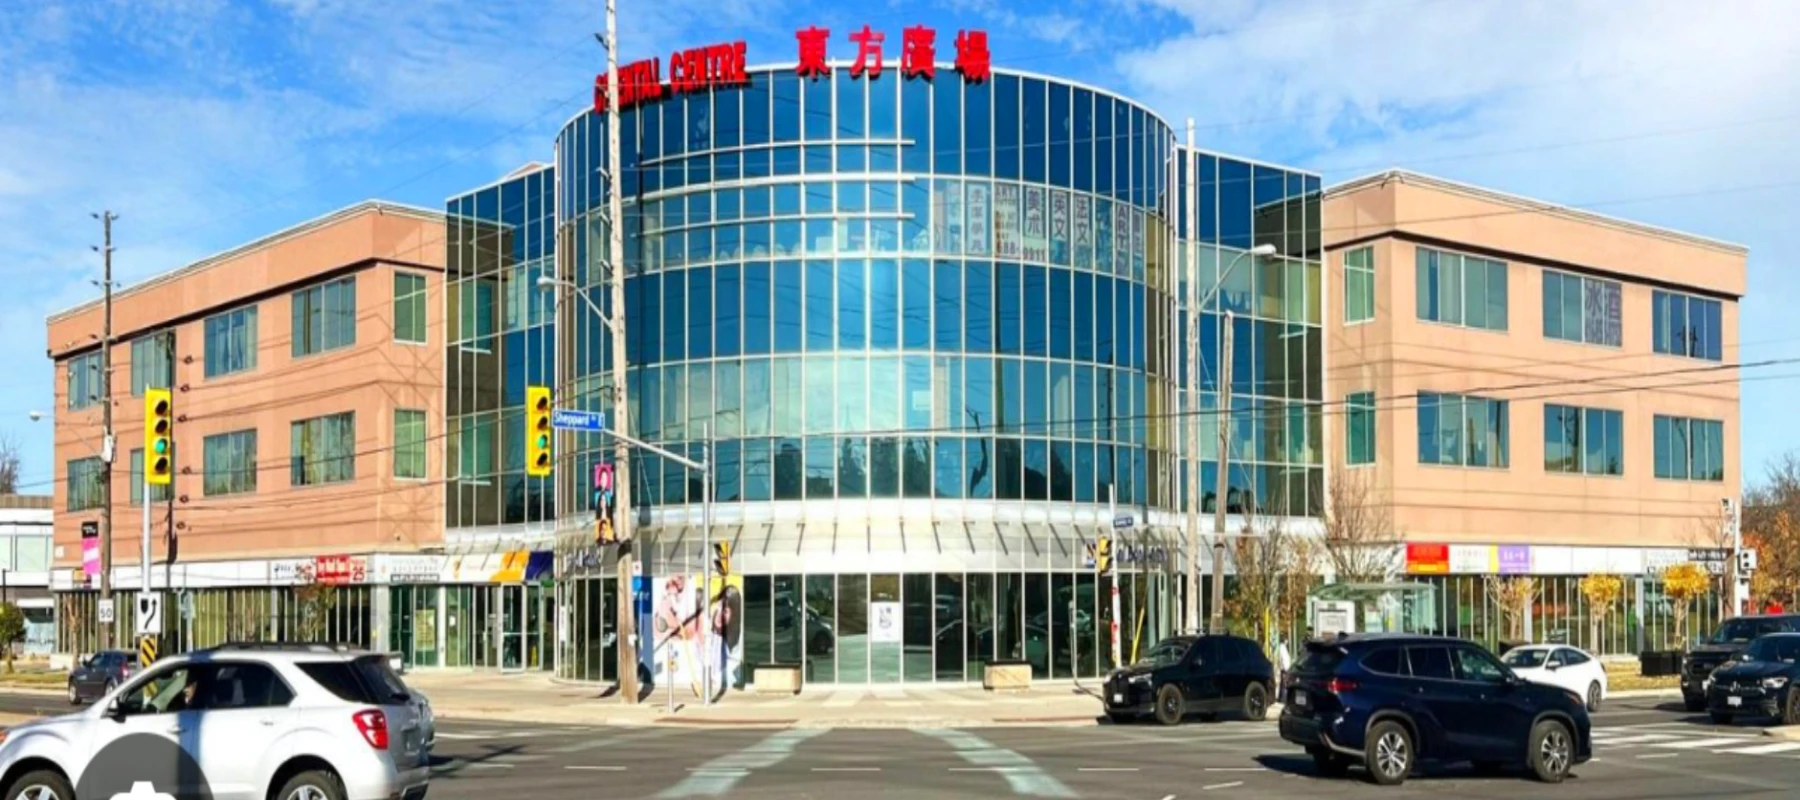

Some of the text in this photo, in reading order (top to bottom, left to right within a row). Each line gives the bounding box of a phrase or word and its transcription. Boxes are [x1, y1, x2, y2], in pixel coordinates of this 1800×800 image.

[670, 40, 746, 93] CENTRE
[796, 24, 990, 82] 東方廣場
[1054, 191, 1066, 239] 英文
[1076, 197, 1088, 243] 法文
[1117, 205, 1127, 249] ART
[555, 411, 589, 426] Sheppard
[100, 607, 113, 619] 50
